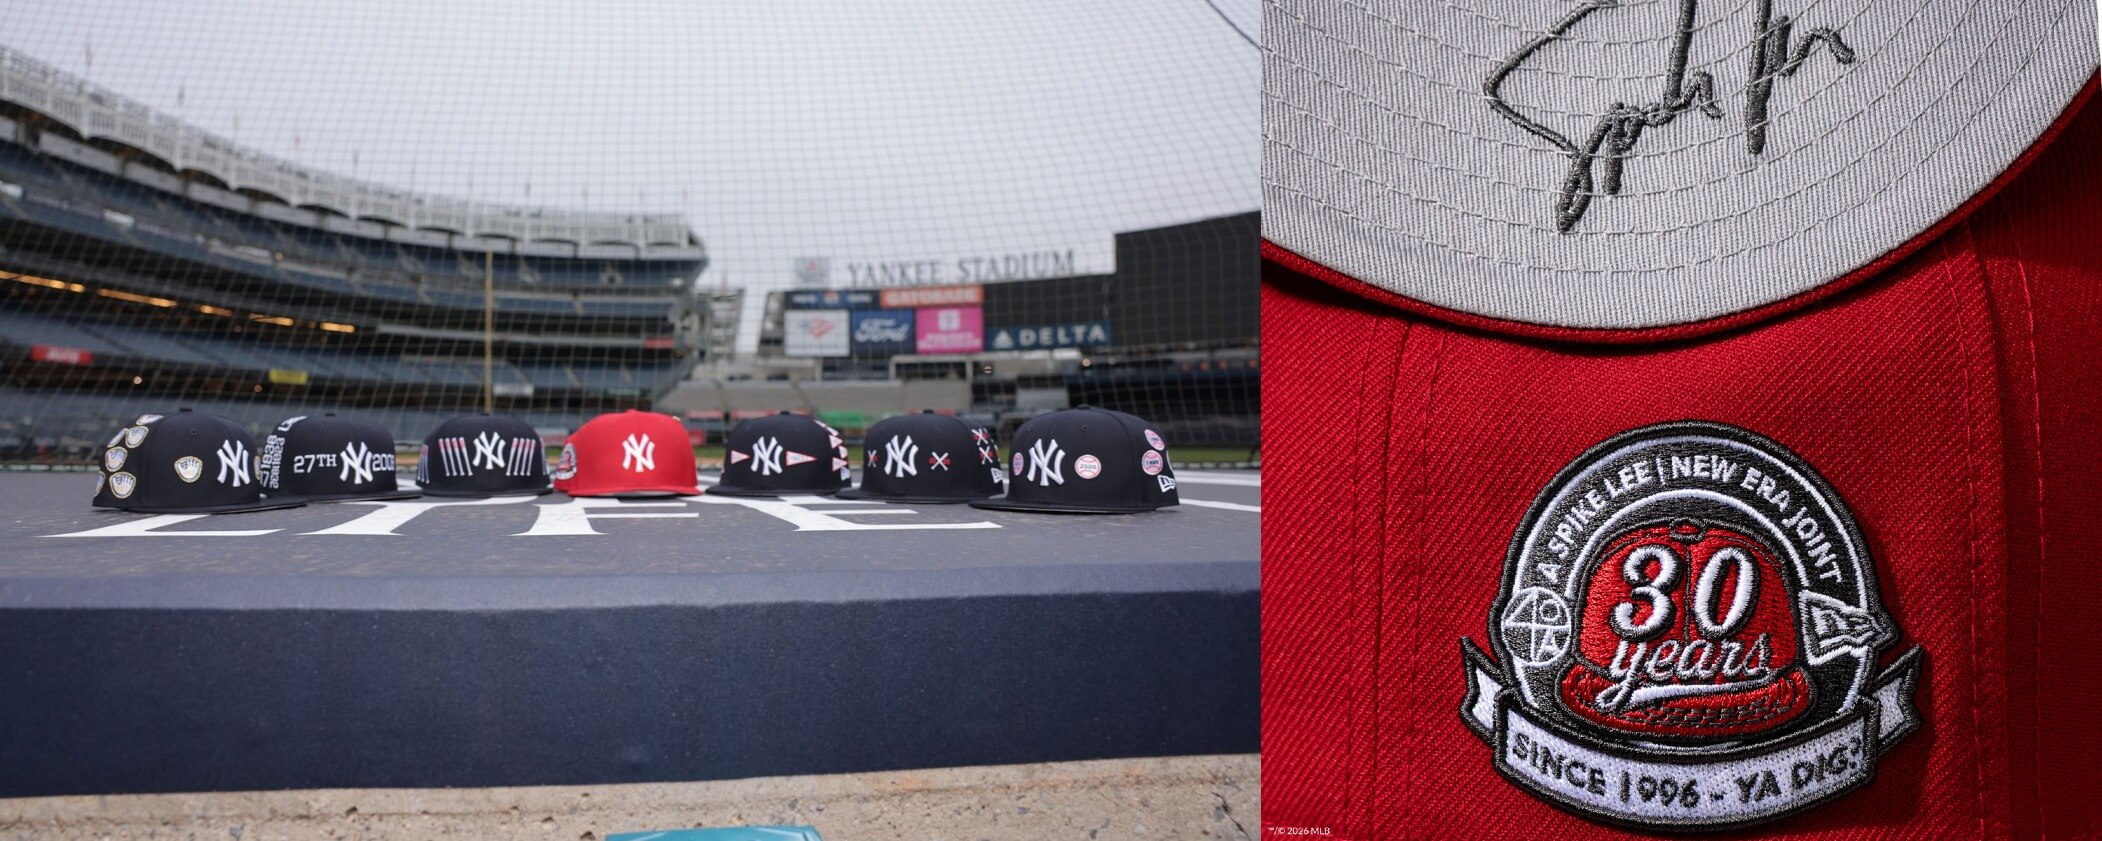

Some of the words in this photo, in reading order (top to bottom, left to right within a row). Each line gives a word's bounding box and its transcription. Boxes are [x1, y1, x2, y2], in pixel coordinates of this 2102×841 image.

[847, 261, 944, 290] YANKEE
[957, 248, 1076, 283] STADIUM
[854, 318, 909, 343] Ford
[1018, 323, 1108, 348] DELTA
[293, 453, 337, 473] 27TH
[1537, 561, 1561, 584] A
[1549, 487, 1605, 562] SPIKE
[1605, 460, 1653, 500] LEE
[1669, 454, 1734, 483] NEW
[1742, 466, 1790, 509] ERA
[1780, 506, 1843, 586] JOINT
[1608, 543, 1762, 640] 30
[1594, 631, 1776, 708] years
[1511, 733, 1607, 797] SINCE
[1617, 768, 1701, 809] 1996
[1733, 769, 1783, 804] YA
[1788, 736, 1863, 787] DIG?
